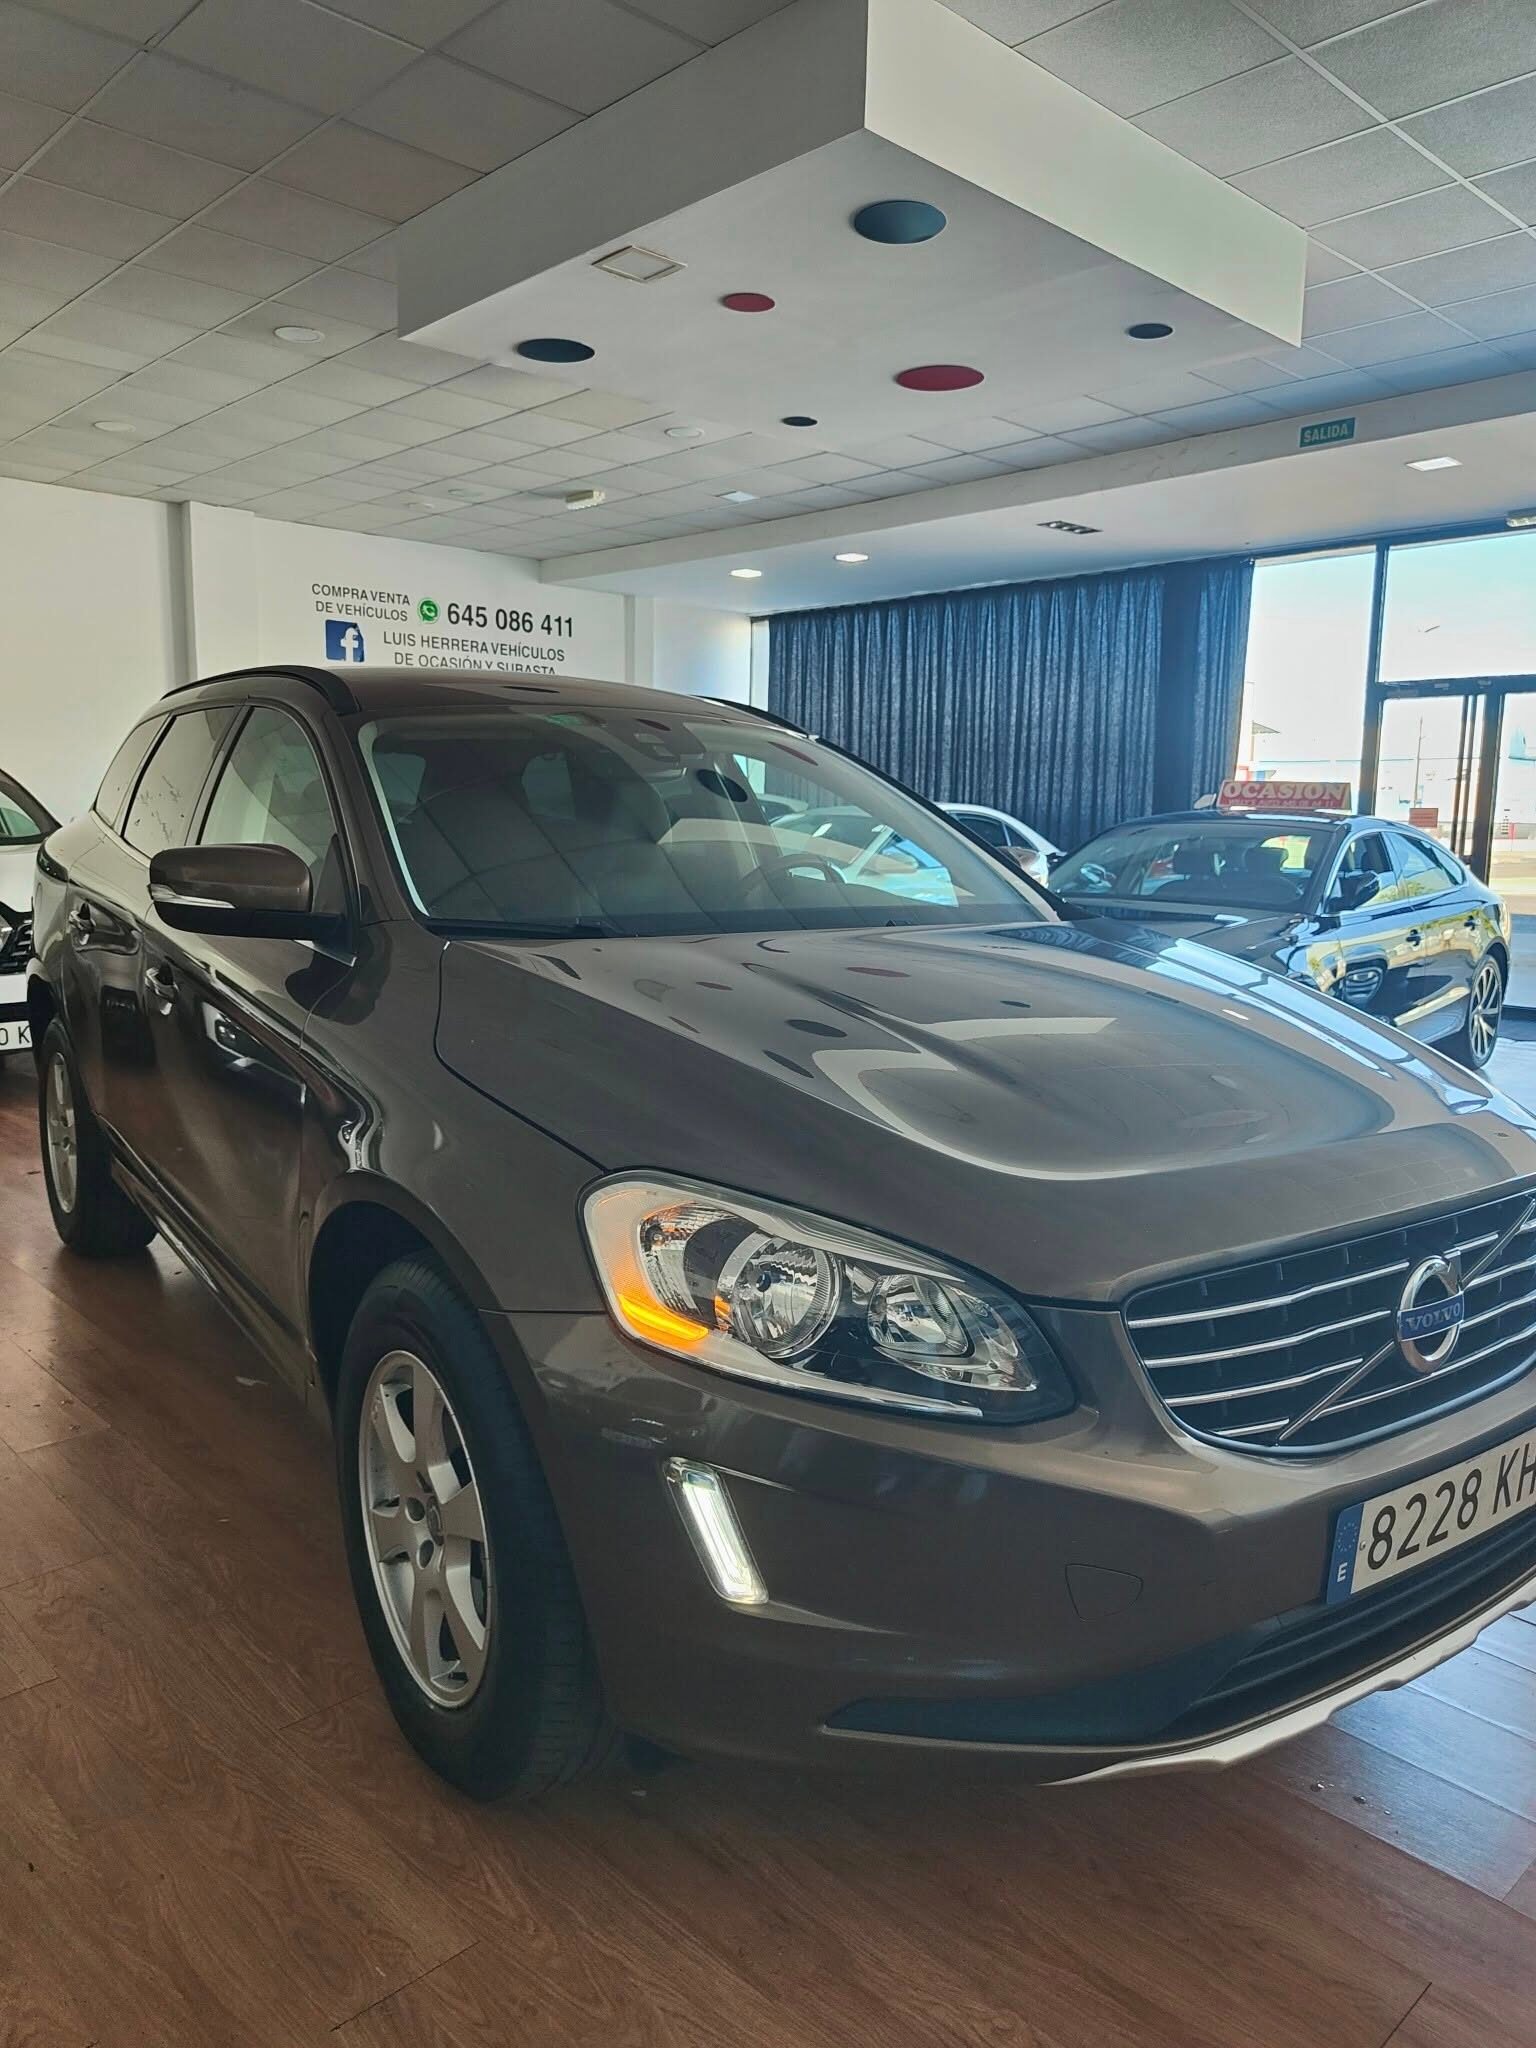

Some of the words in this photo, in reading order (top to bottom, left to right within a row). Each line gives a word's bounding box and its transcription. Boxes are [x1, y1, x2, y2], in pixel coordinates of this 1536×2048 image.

[1303, 423, 1348, 443] SALIDA
[315, 600, 333, 613] DE
[336, 602, 408, 622] VEHÍCULOS
[447, 602, 488, 628] 645
[495, 608, 534, 633] 086
[541, 614, 572, 637] 411
[383, 631, 416, 647] LUIS
[421, 635, 489, 654] HERRERA
[491, 641, 565, 662] VEHÍCULOS
[394, 652, 414, 666] DE
[418, 655, 482, 670] OCASIÓN
[1223, 782, 1344, 800] OCASION
[18, 1025, 30, 1044] K
[1406, 1302, 1461, 1331] VOLVO
[1367, 1468, 1482, 1570] 8228
[1492, 1443, 1536, 1515] KH
[1337, 1562, 1348, 1583] E
